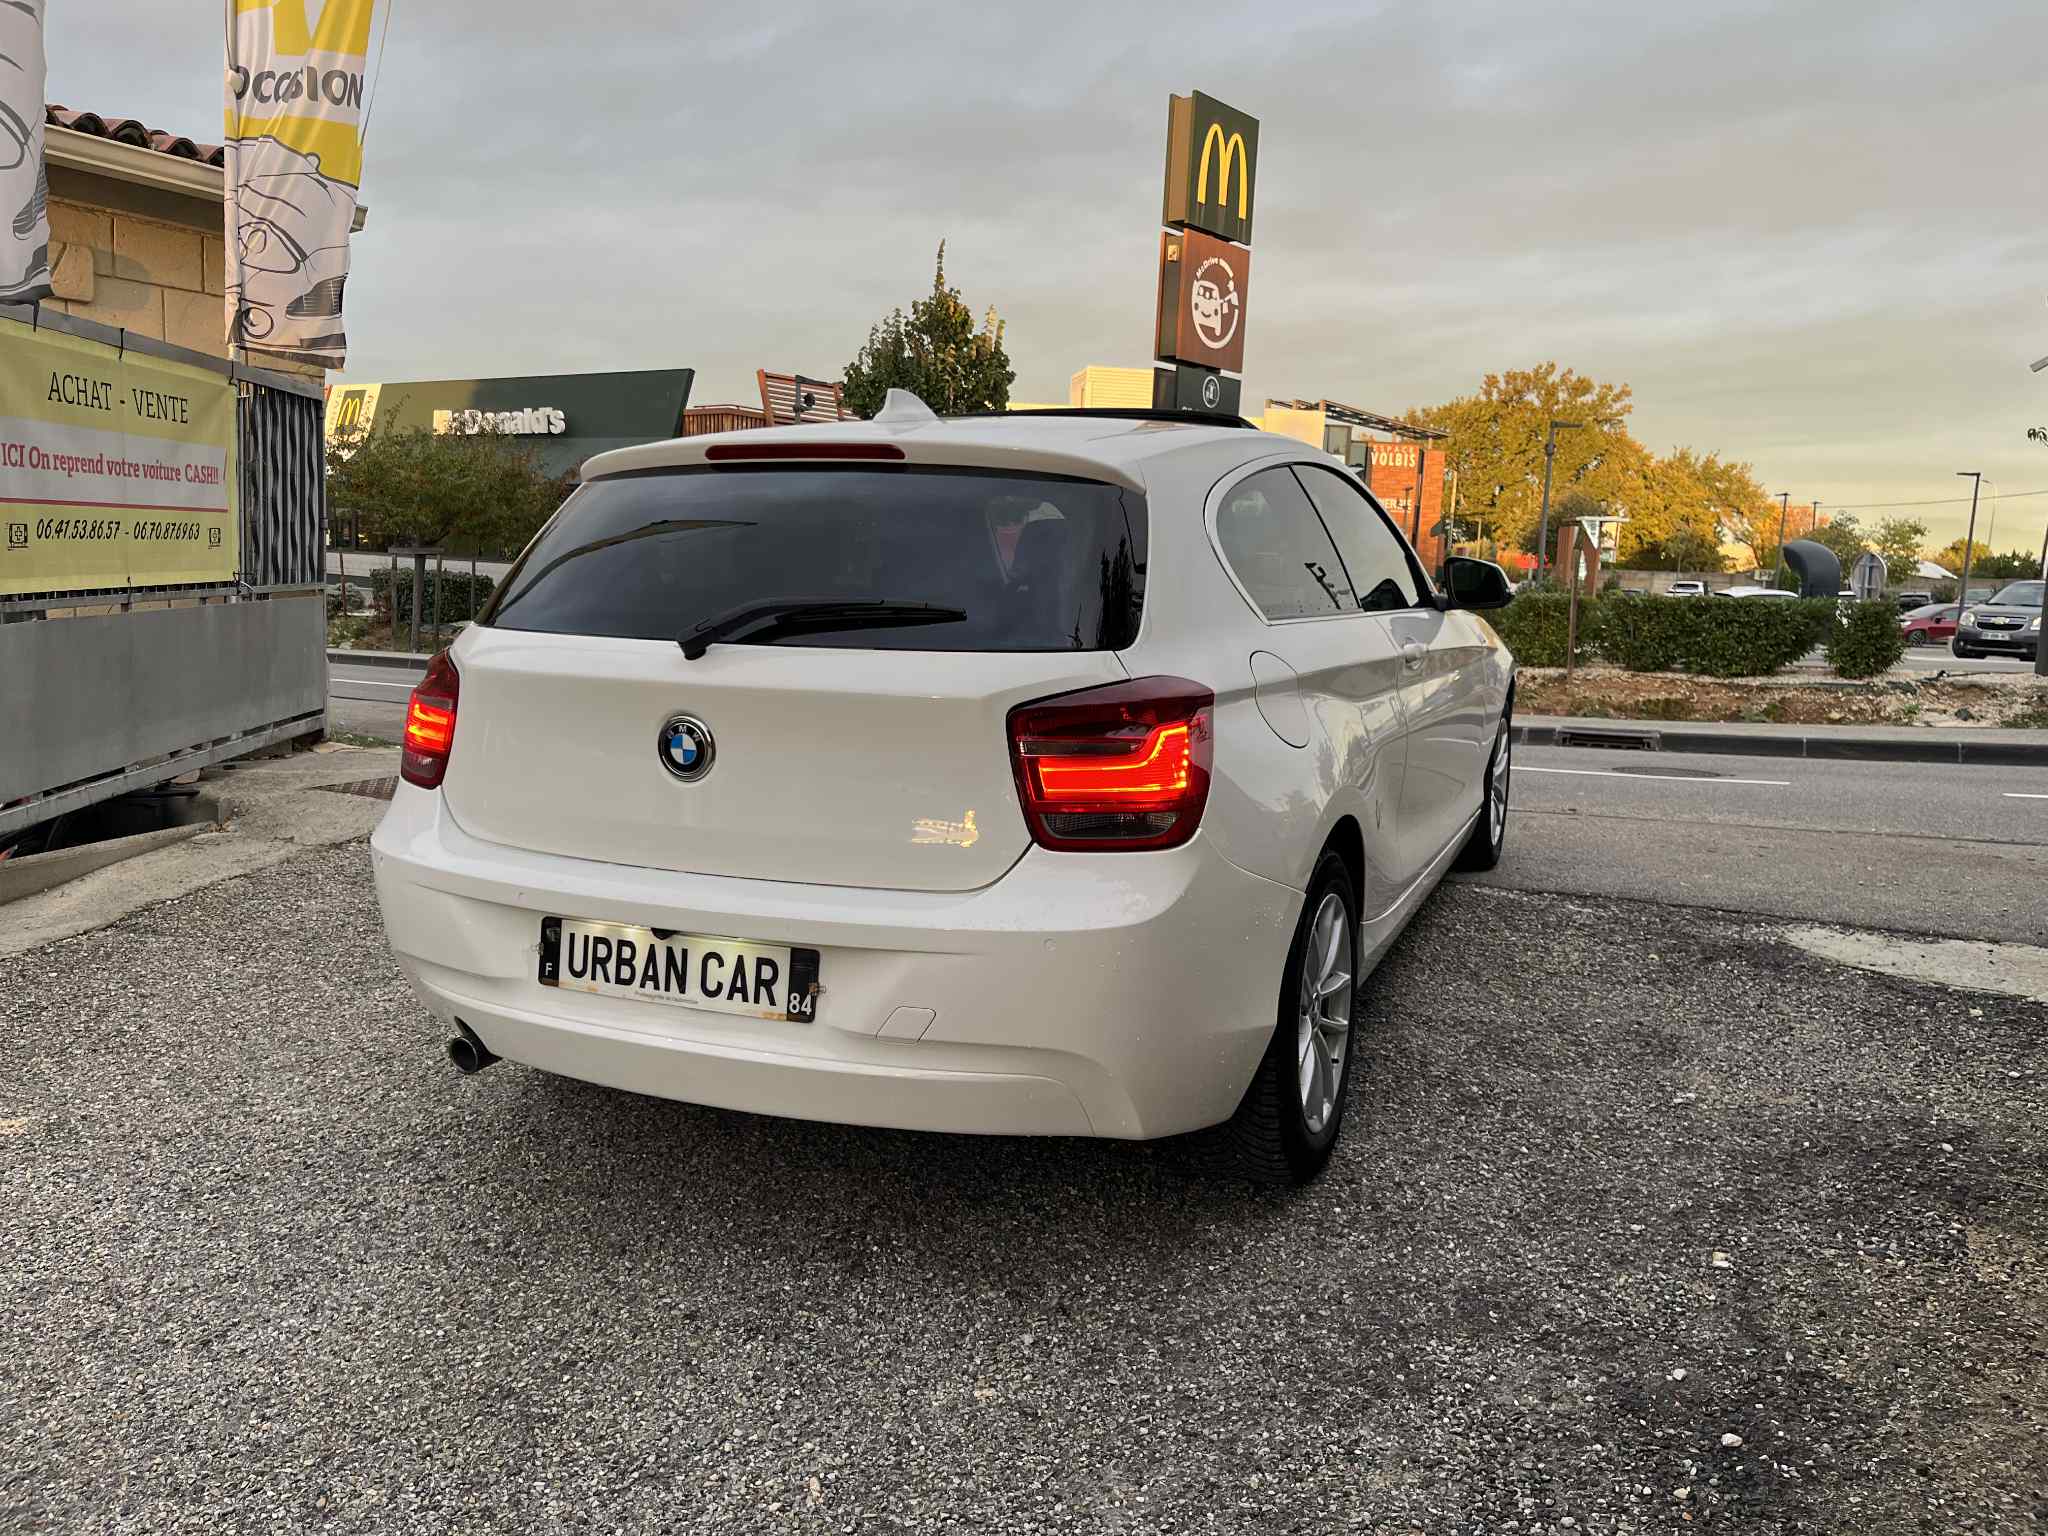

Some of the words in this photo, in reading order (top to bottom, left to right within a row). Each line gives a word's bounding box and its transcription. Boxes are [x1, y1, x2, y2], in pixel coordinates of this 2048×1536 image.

[235, 65, 364, 110] OCCSION
[47, 371, 112, 411] ACHAT
[132, 388, 189, 424] VENTE
[1, 442, 26, 468] ICI
[29, 446, 51, 470] On
[52, 453, 104, 477] reprend
[106, 458, 140, 478] votre
[142, 459, 181, 482] voiture
[1371, 451, 1415, 468] VOLBIS
[36, 518, 120, 540] 06.41.53.86.57
[568, 932, 689, 995] URBAN
[700, 951, 779, 1006] CAR
[789, 993, 813, 1016] 84
